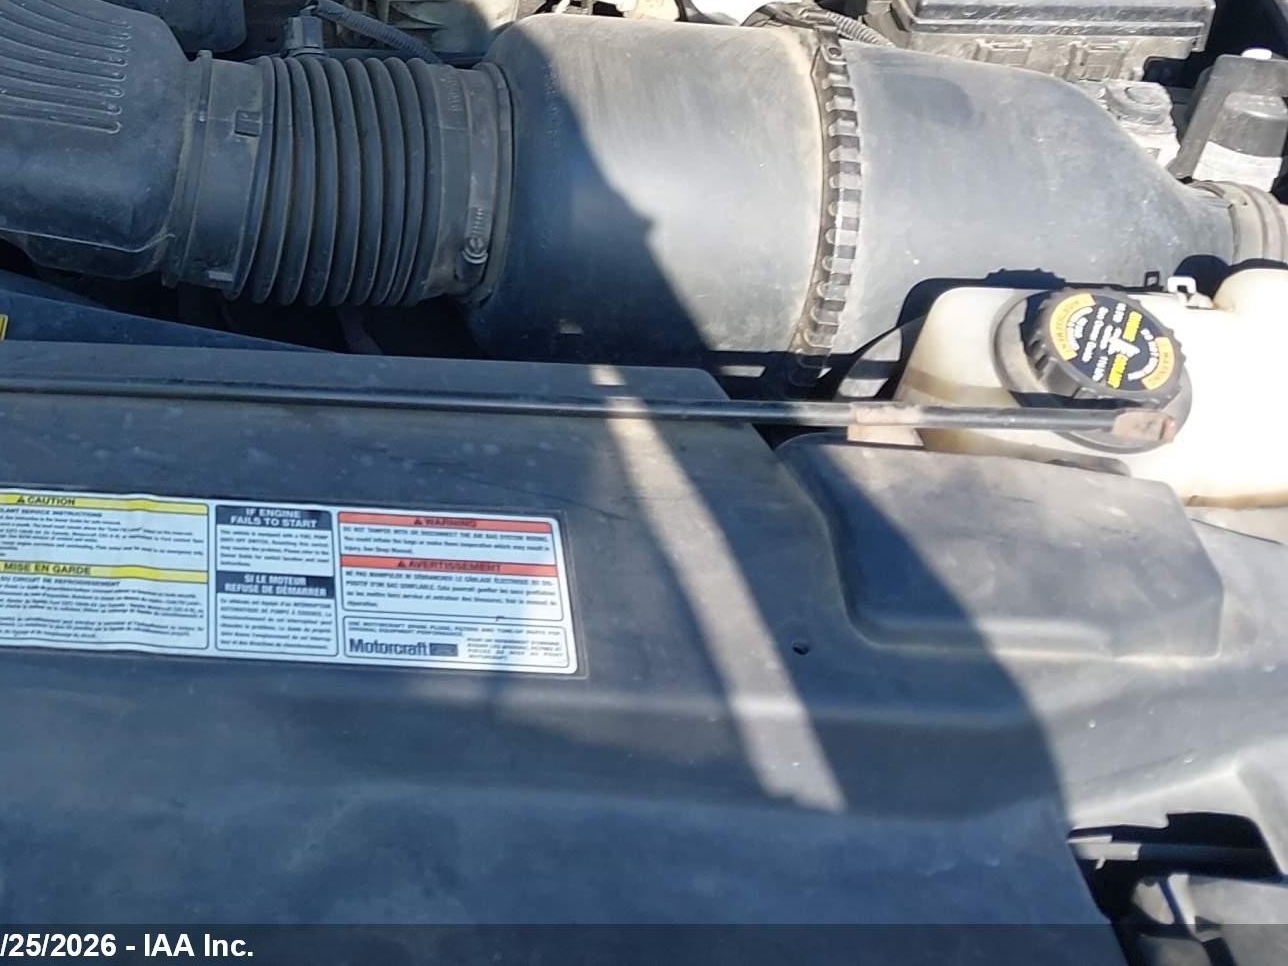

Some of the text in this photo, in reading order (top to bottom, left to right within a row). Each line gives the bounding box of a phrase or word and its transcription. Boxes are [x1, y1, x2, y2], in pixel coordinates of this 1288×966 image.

[27, 496, 76, 506] CAUTION
[259, 508, 301, 518] ENGINE
[230, 515, 317, 528] FAILS TO START
[4, 562, 91, 575] MISE EN GARDE
[244, 574, 254, 583] SI
[256, 574, 266, 584] LE
[349, 638, 426, 656] Motorcraft
